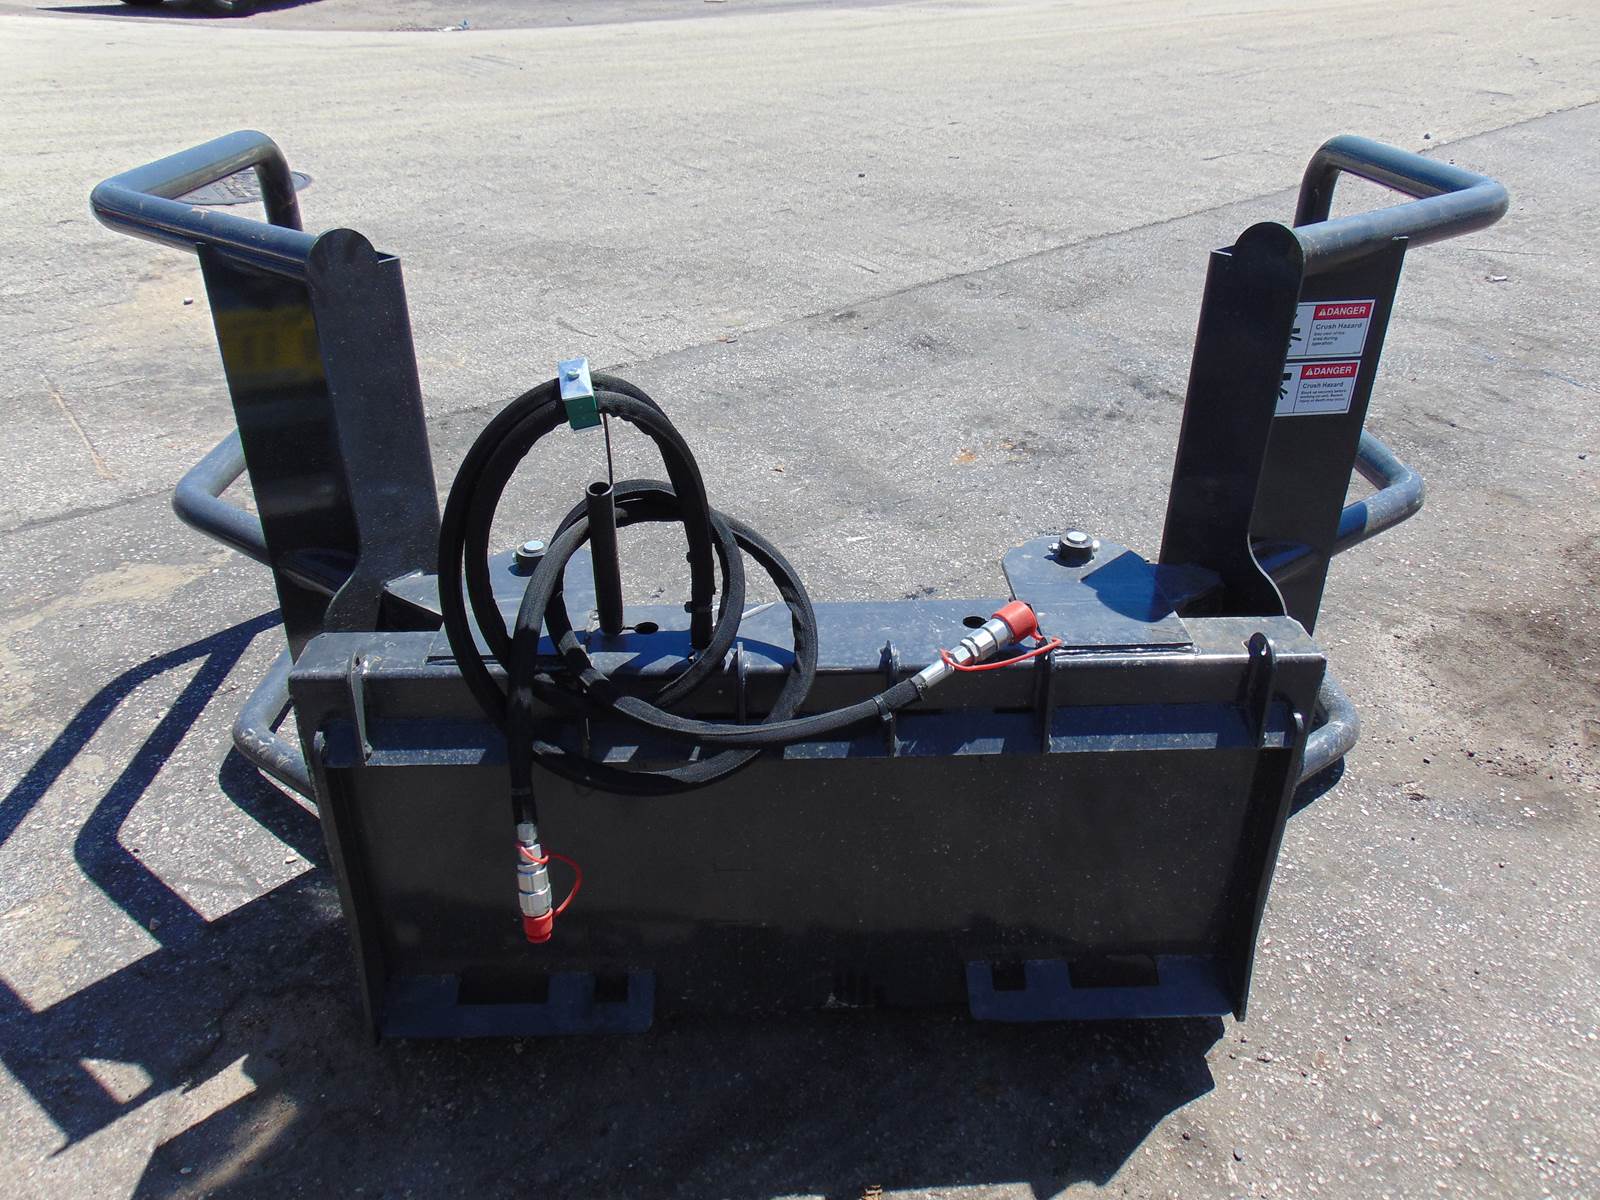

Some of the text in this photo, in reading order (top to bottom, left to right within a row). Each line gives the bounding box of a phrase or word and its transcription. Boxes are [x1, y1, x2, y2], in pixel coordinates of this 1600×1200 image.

[1327, 306, 1366, 316] DANGER
[1315, 321, 1362, 330] Crush Hazard
[1313, 366, 1352, 375] DANGER
